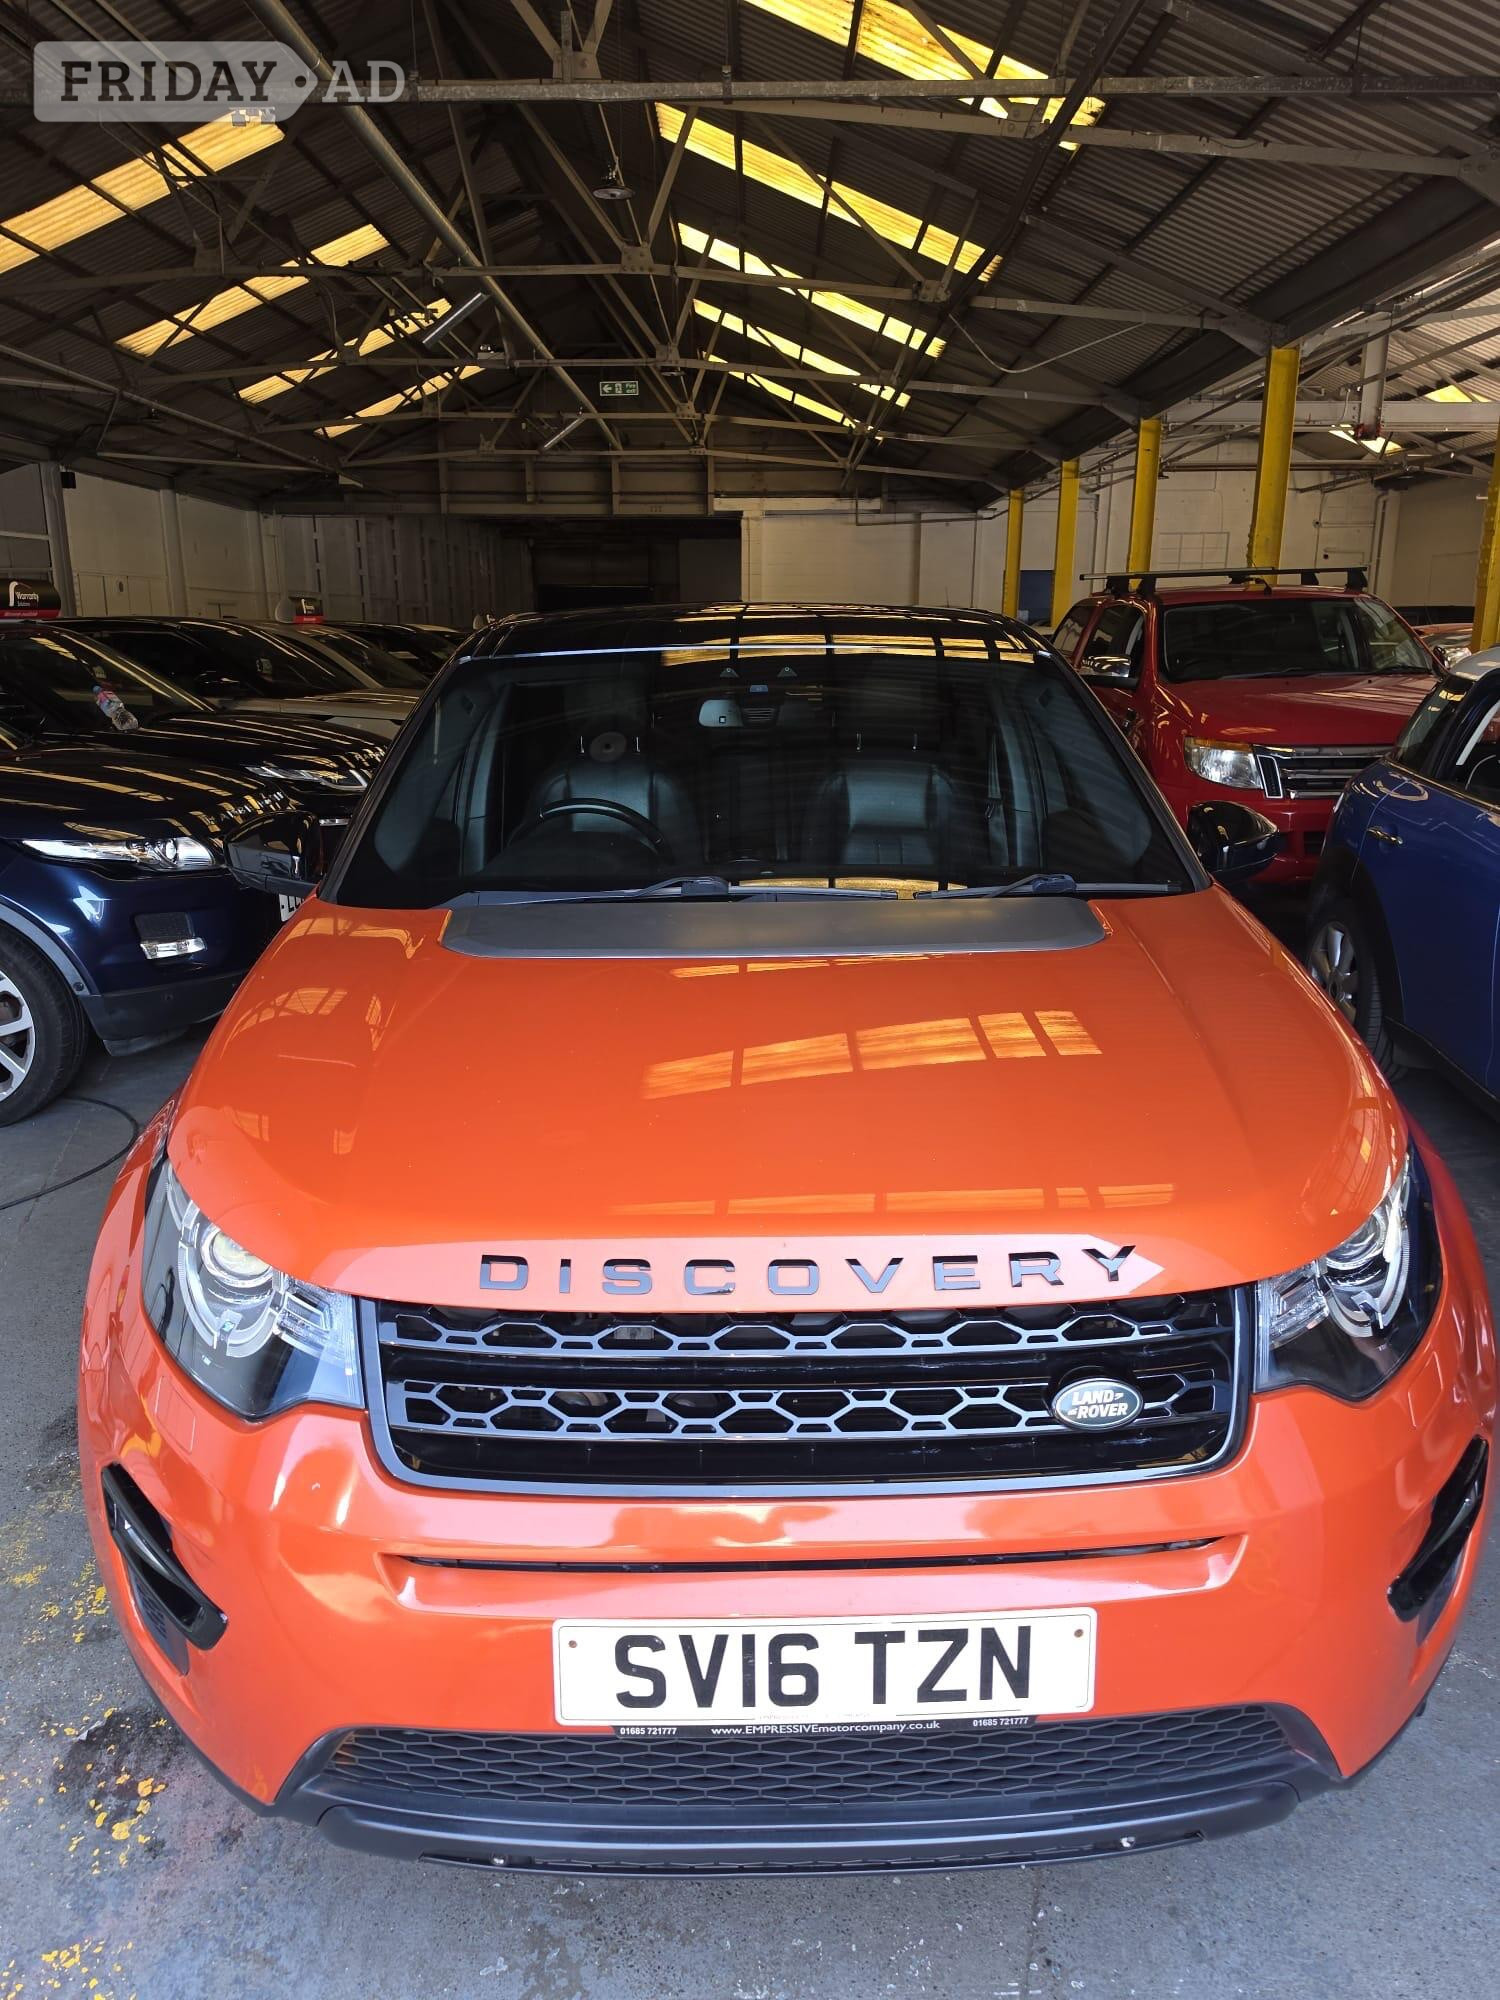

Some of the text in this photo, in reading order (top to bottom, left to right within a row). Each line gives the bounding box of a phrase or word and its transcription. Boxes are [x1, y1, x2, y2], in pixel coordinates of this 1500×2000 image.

[480, 1245, 1136, 1295] DISCOVERY
[1072, 1389, 1114, 1406] LAND
[1077, 1402, 1128, 1419] ROVER
[615, 1625, 1031, 1709] SV16 TZN
[711, 1720, 941, 1735] www.EMPRESSIVEmotorcompany.co.uk
[972, 1716, 1029, 1727] 01685 721777
[619, 1726, 677, 1735] 01685 721777
